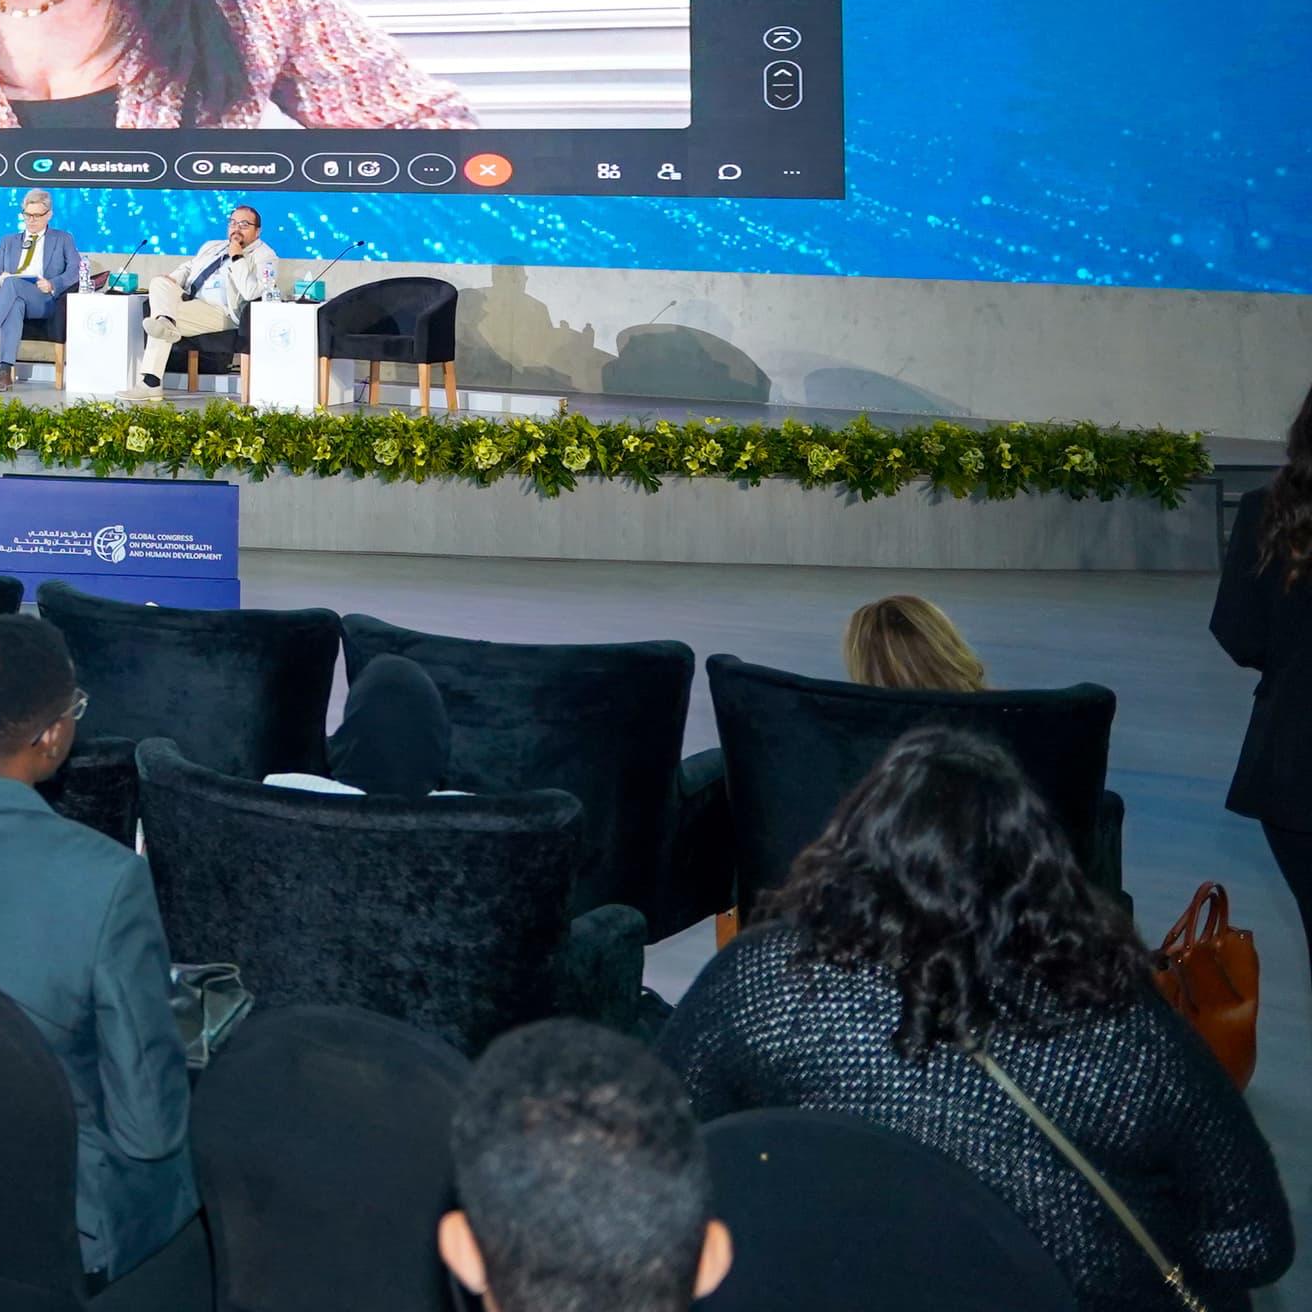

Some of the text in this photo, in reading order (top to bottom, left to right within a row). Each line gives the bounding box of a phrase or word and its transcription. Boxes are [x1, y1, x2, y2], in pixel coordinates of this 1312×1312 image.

[58, 160, 150, 173] AI Assistant
[220, 162, 276, 175] Record
[129, 533, 194, 542] GLOBAL CONGRESS
[186, 543, 213, 551] HEALTH
[145, 551, 171, 559] HUMAN
[172, 552, 223, 561] DEVELOPMENT
